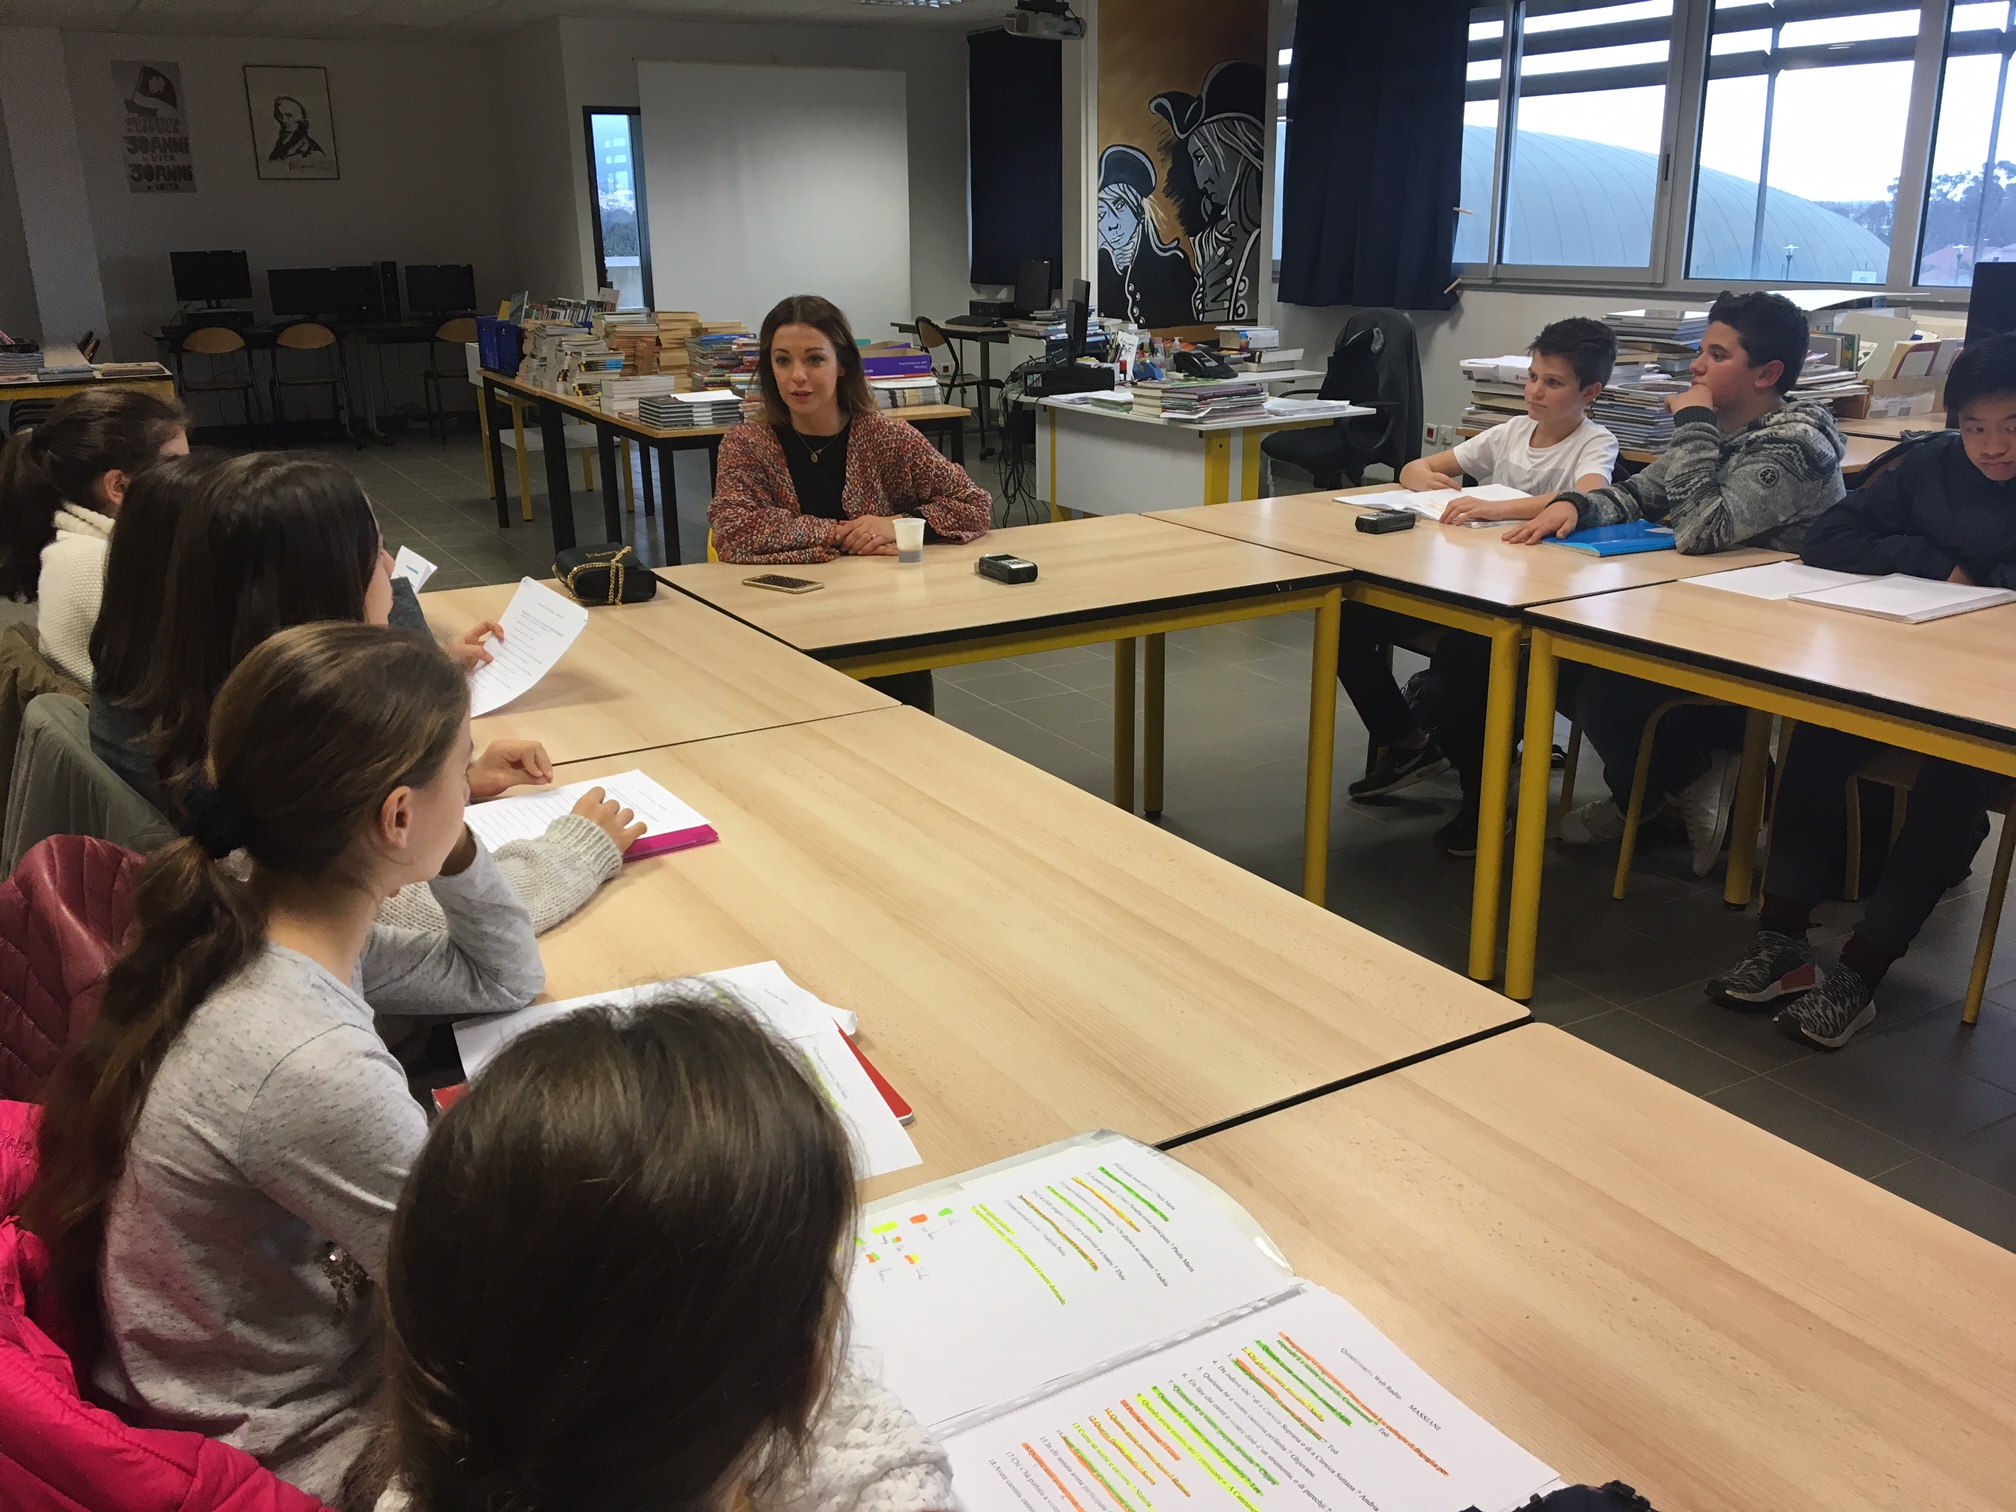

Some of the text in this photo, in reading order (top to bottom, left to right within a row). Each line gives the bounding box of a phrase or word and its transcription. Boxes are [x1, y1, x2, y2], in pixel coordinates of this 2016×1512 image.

[1156, 1272, 1167, 1286] Andria
[1183, 1258, 1194, 1272] Maria
[1140, 1399, 1161, 1418] Quandu
[1158, 1417, 1171, 1430] avete
[1373, 1375, 1386, 1386] Web
[1385, 1385, 1402, 1399] Radio
[1409, 1404, 1440, 1430] MASSIANI
[1202, 1371, 1225, 1392] Qualessa
[1265, 1431, 1287, 1451] priferita
[1289, 1453, 1315, 1477] Ghjuvanu
[1195, 1386, 1206, 1396] fate
[1266, 1454, 1294, 1480] strumentu,
[1303, 1488, 1326, 1509] parechji
[1225, 1372, 1243, 1388] induve
[1240, 1386, 1251, 1395] site
[1262, 1406, 1282, 1424] Corsica
[1280, 1423, 1302, 1443] Suprana
[1315, 1454, 1336, 1473] Corsica
[1335, 1472, 1356, 1491] Suttana
[1359, 1493, 1379, 1512] Andria
[1056, 1456, 1073, 1472] annata
[1070, 1471, 1084, 1486] avete
[1414, 1447, 1437, 1468] Biguglia
[1005, 1479, 1023, 1498] cantatu
